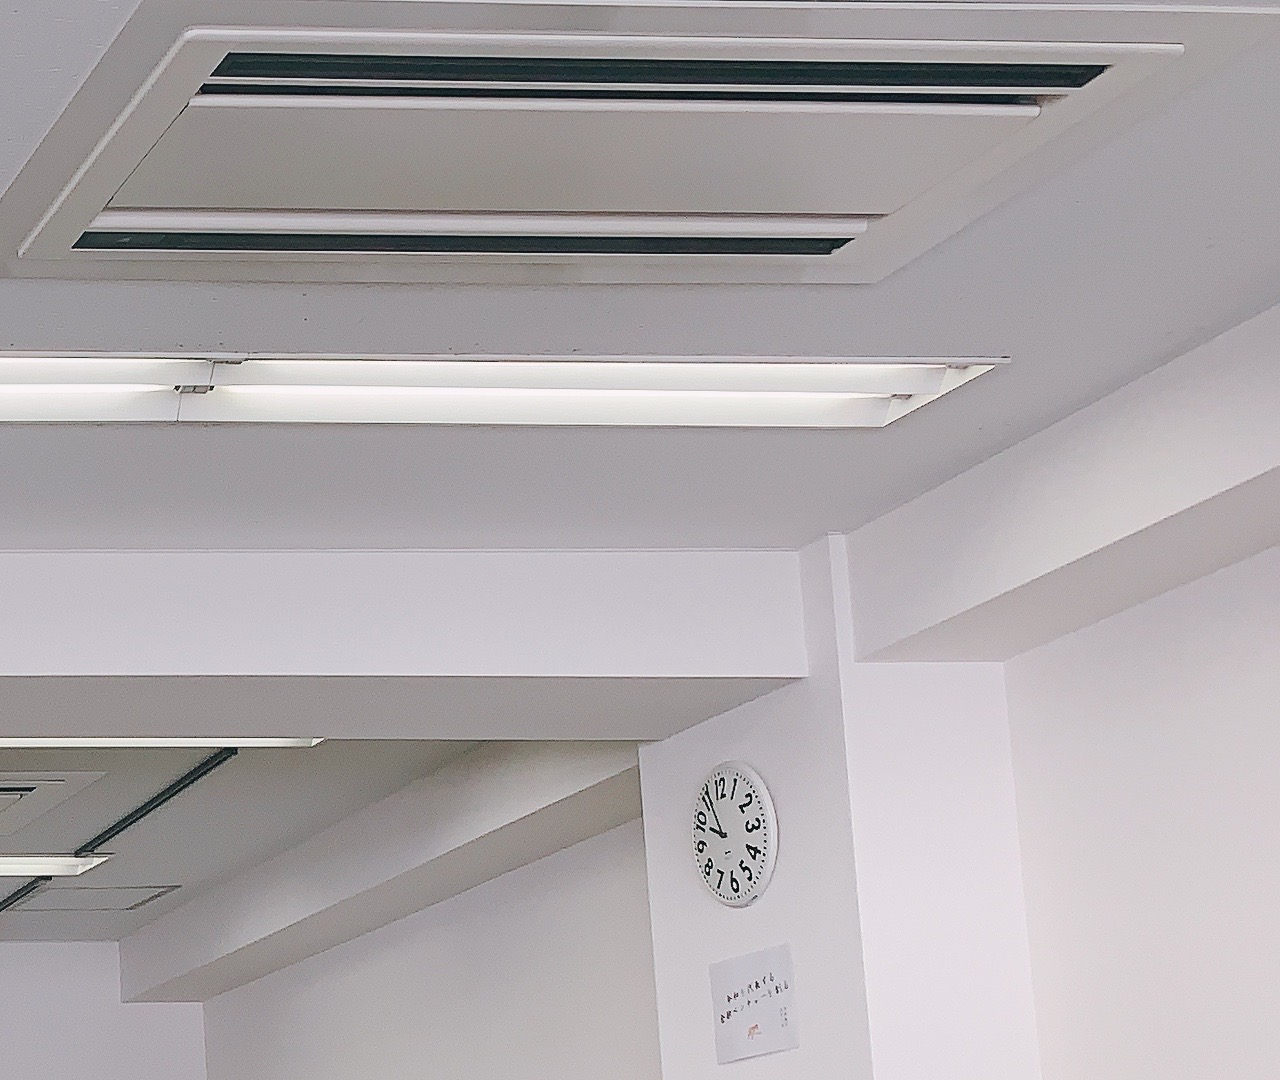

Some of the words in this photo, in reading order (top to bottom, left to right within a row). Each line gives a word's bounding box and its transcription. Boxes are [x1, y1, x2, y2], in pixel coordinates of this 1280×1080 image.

[714, 777, 727, 801] 12
[730, 777, 738, 801] 1
[738, 792, 753, 814] 2
[695, 810, 708, 833] 10
[745, 817, 761, 833] 3
[696, 840, 708, 854] 9
[745, 843, 762, 861] 4
[704, 857, 714, 877] 8
[738, 859, 753, 882] 5
[716, 868, 725, 890] 7
[730, 869, 740, 893] 6
